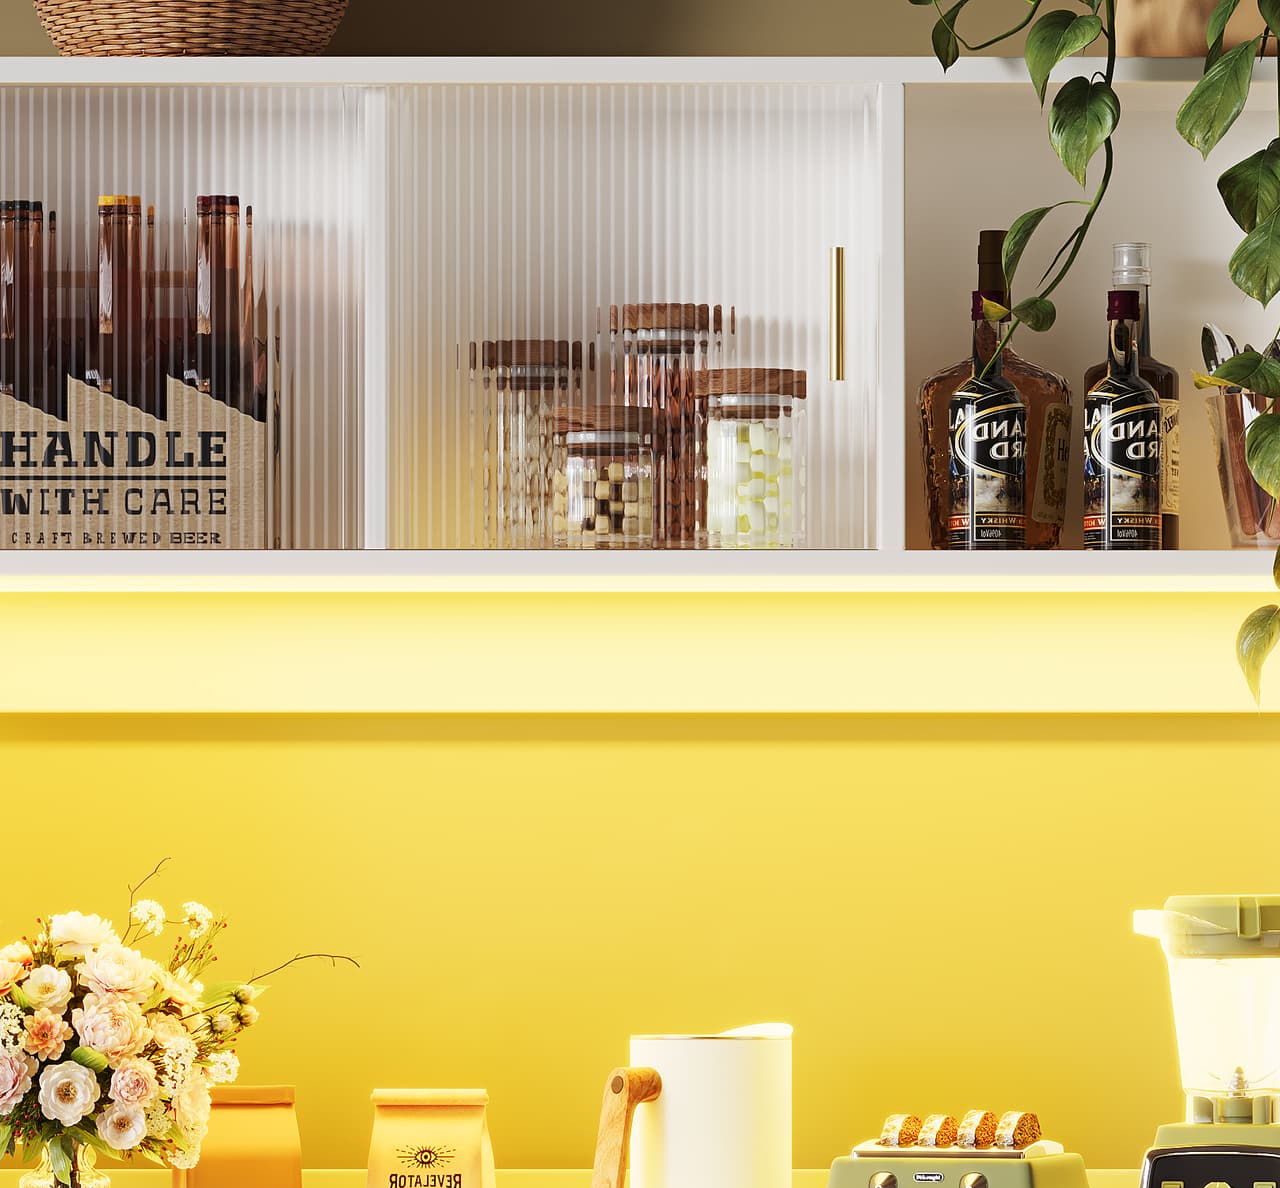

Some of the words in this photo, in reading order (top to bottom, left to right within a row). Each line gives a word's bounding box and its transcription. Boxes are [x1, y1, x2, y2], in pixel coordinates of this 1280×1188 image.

[0, 431, 227, 468] HANDLE
[0, 488, 110, 515] WITH
[124, 488, 227, 515] CARE
[11, 532, 73, 545] CRAFT
[82, 532, 162, 545] BREWED
[169, 532, 223, 545] BEER
